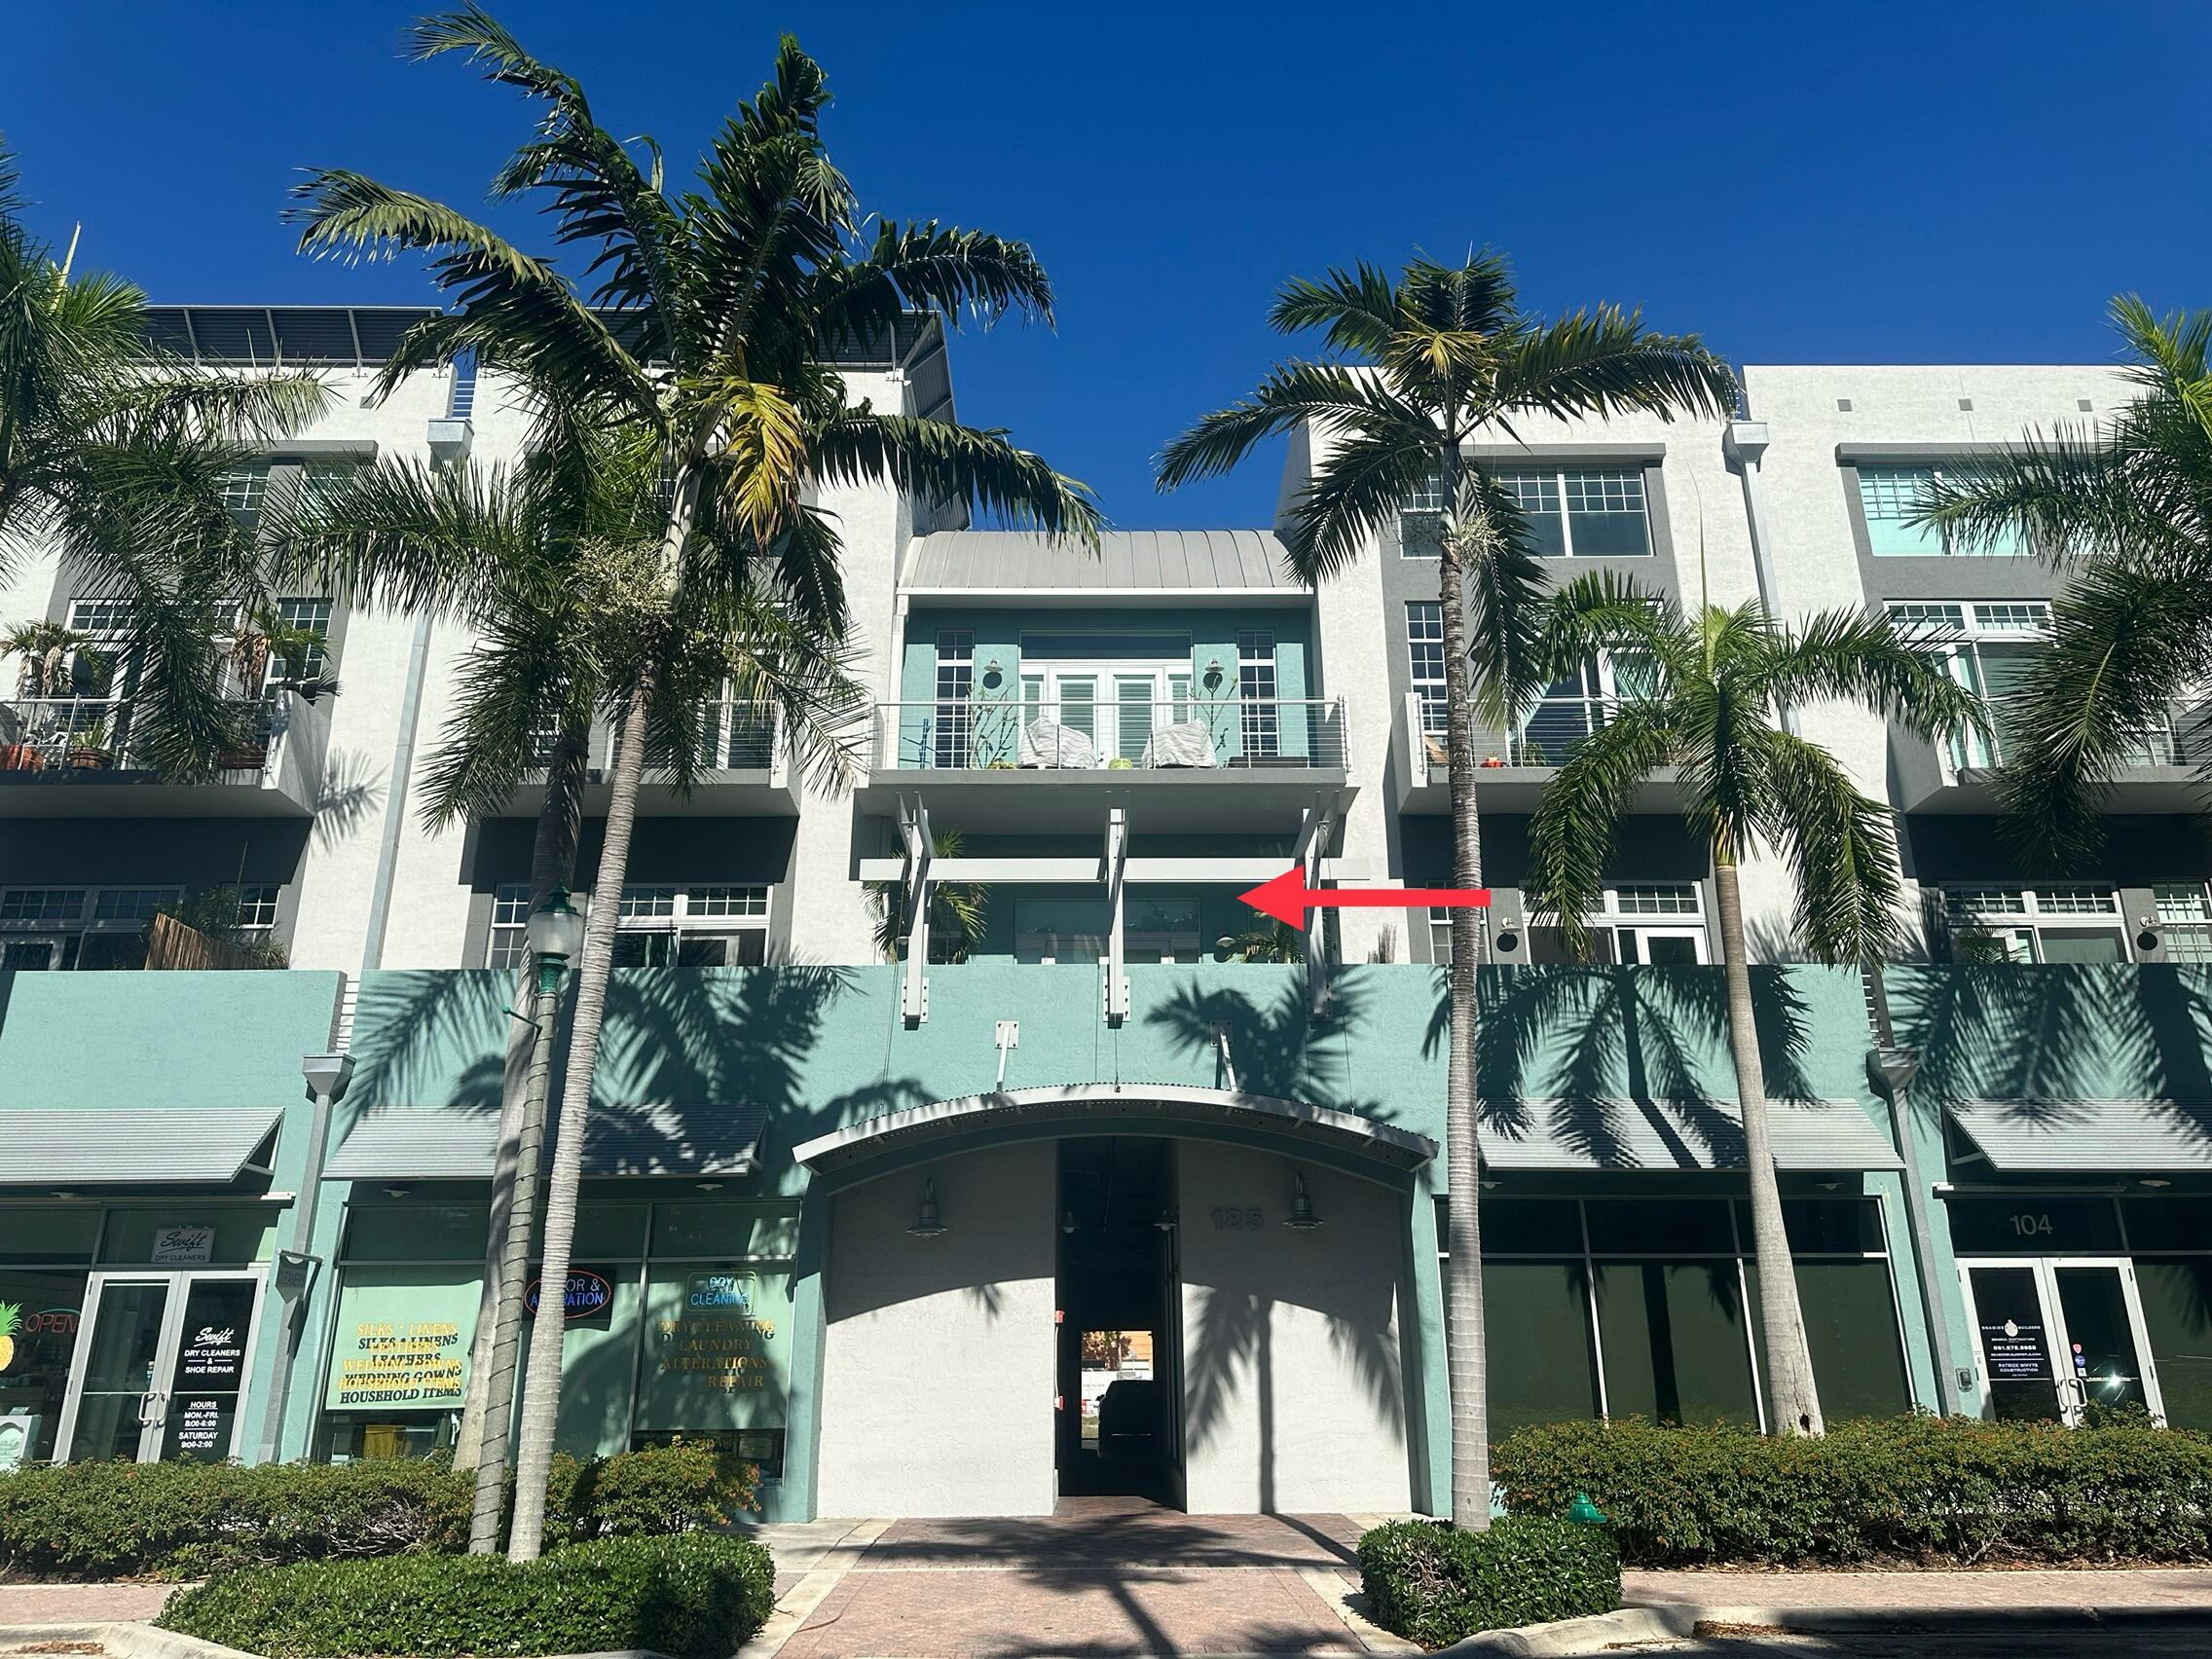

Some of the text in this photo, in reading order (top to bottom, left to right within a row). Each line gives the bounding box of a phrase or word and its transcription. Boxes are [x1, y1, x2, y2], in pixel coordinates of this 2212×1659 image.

[1209, 1208, 1264, 1232] 185
[2009, 1214, 2053, 1235] 104
[160, 1231, 208, 1252] Swift
[590, 1278, 601, 1292] &
[710, 1276, 734, 1289] DRY
[690, 1292, 749, 1306] CLEANING
[25, 1313, 80, 1333] OPEN
[357, 1322, 459, 1337] SILKS LINENS
[694, 1318, 775, 1333] CLEANING
[195, 1326, 235, 1346] Swift
[680, 1339, 754, 1351] LAUNDRY
[201, 1348, 241, 1357] CLEANERS
[343, 1359, 408, 1372] WEDDING
[660, 1356, 768, 1371] ALTERATIONS
[338, 1378, 418, 1390] HOUSEHOLD
[708, 1375, 764, 1387] REPAIR
[340, 1388, 420, 1404] HOUSEHOLD
[178, 1431, 219, 1440] SATURDAY
